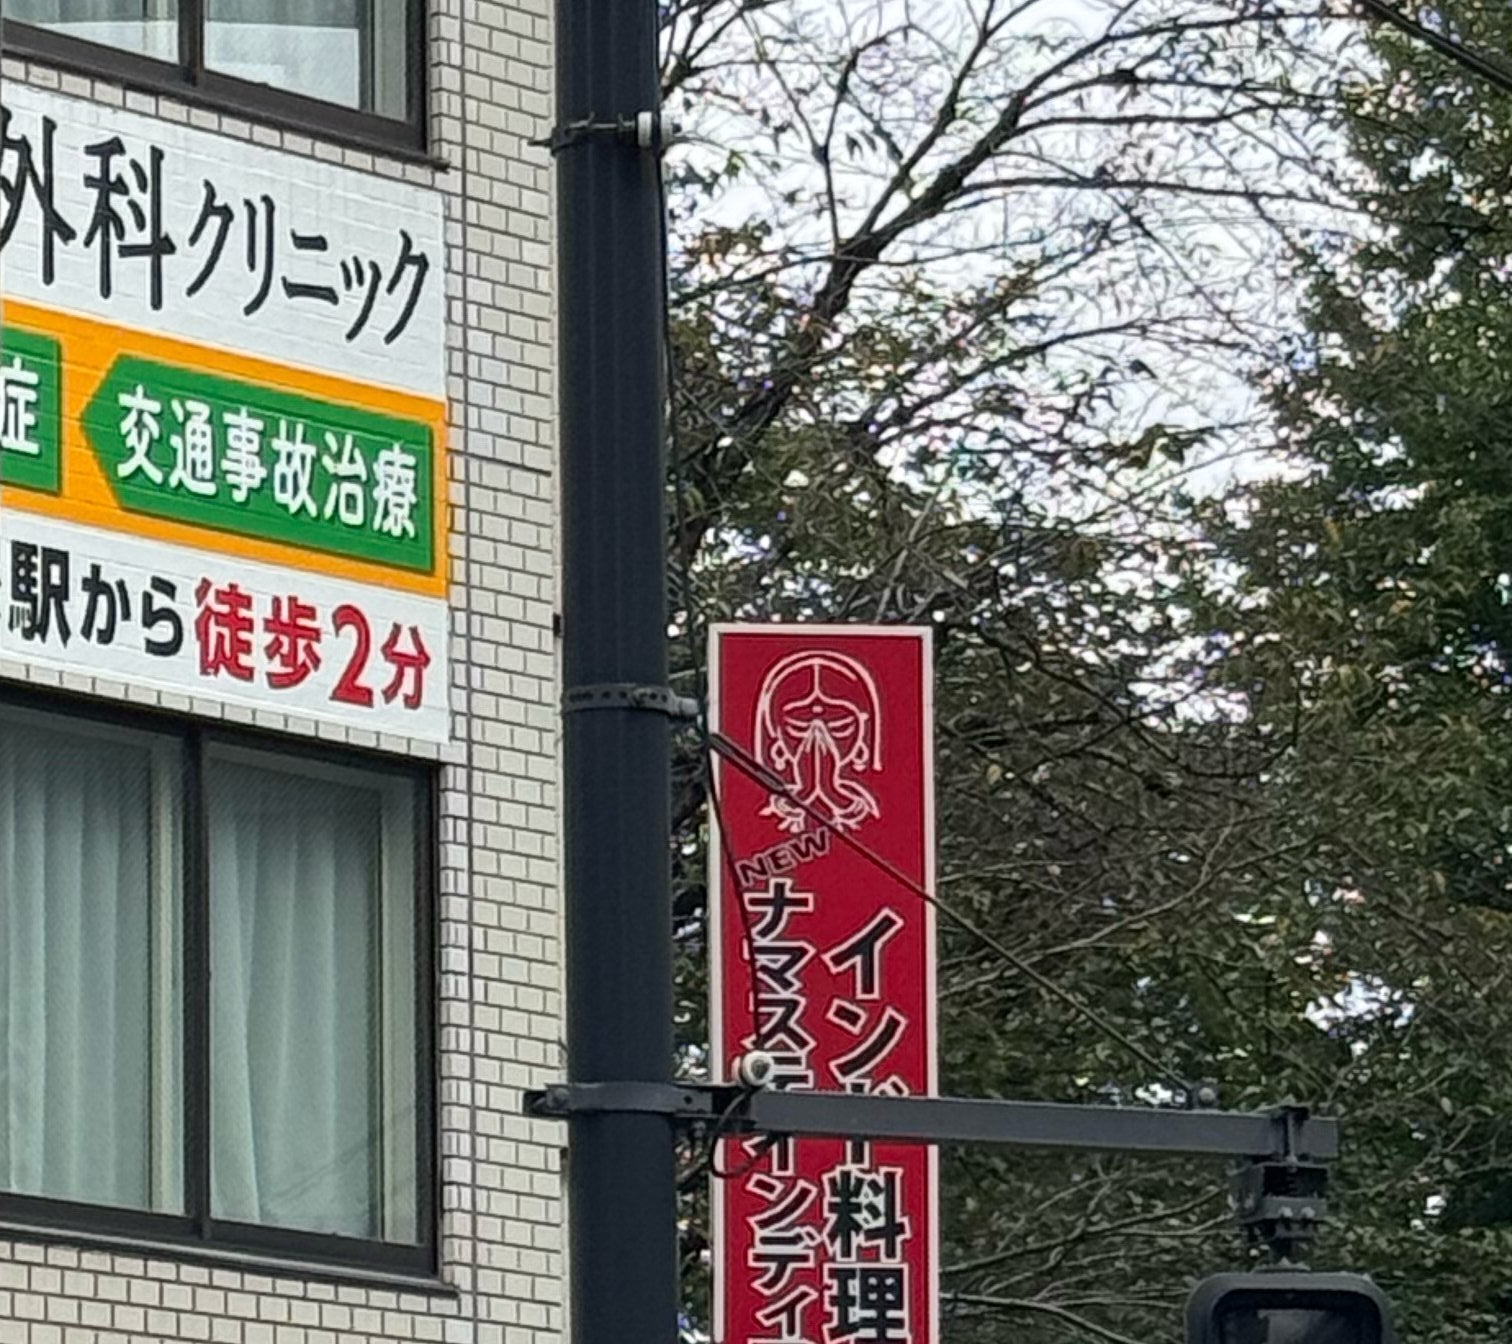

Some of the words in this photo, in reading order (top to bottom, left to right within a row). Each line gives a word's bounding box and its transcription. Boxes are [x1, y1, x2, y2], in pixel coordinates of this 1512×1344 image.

[116, 383, 419, 541] 交通事故治療
[735, 828, 832, 889] NEW
